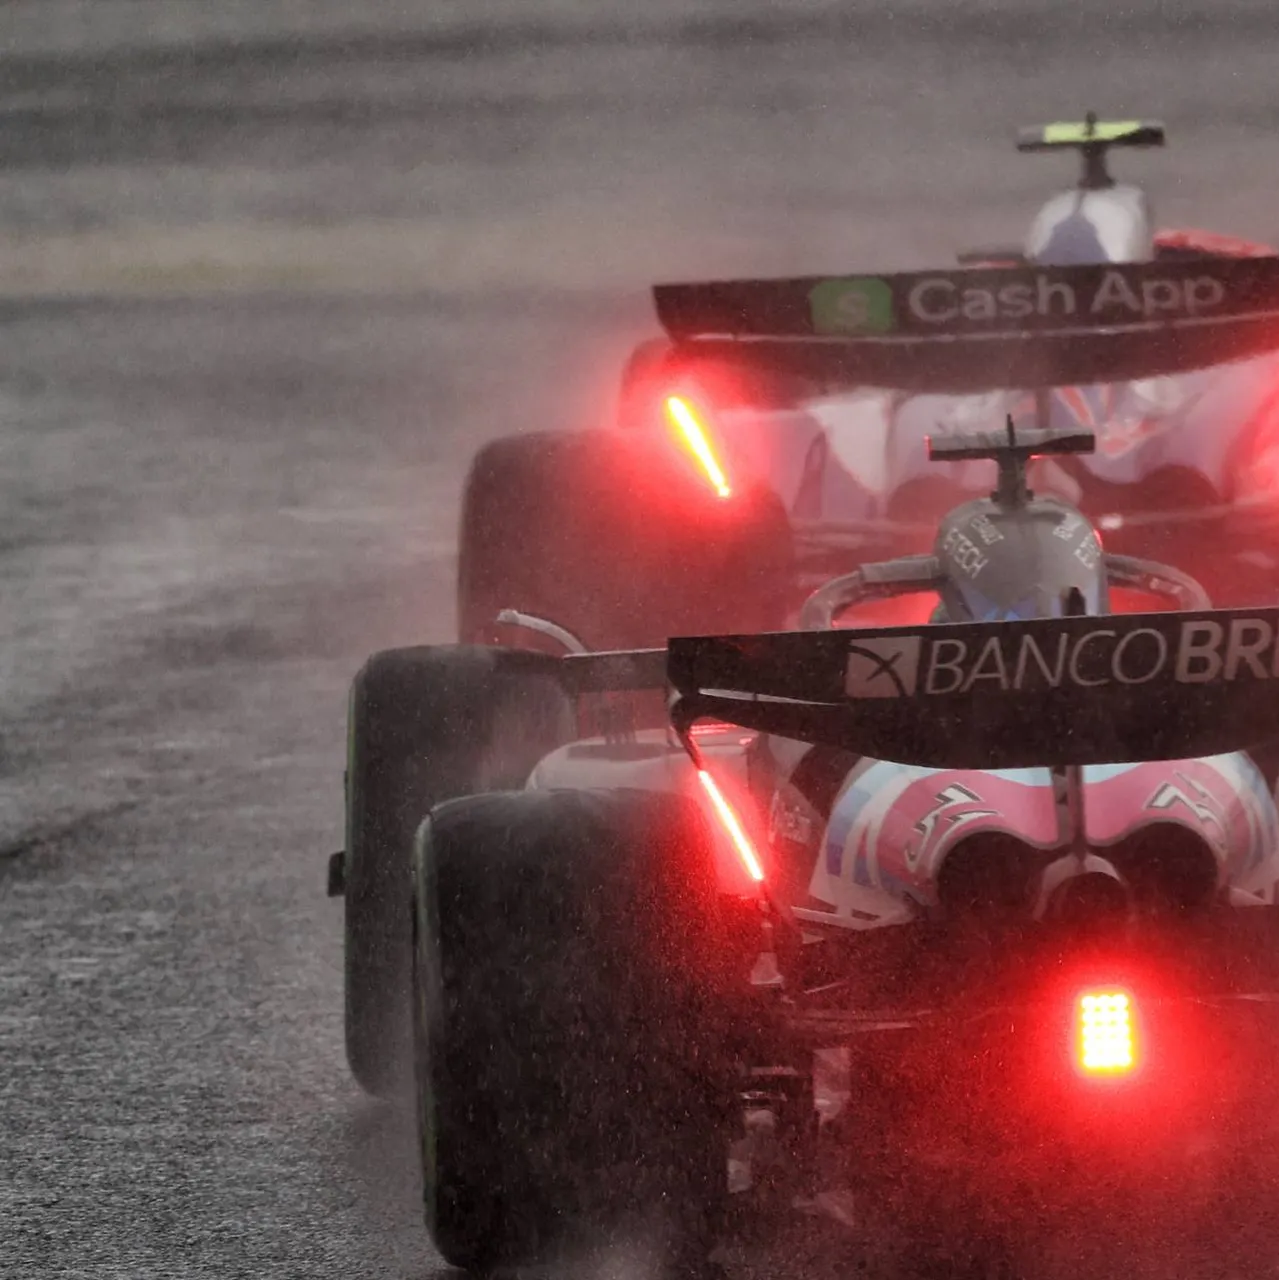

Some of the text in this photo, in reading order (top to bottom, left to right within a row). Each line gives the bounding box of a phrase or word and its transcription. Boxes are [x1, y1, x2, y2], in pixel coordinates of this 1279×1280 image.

[908, 270, 1076, 322] Cash
[1090, 271, 1226, 315] App
[924, 627, 1168, 694] BANCO
